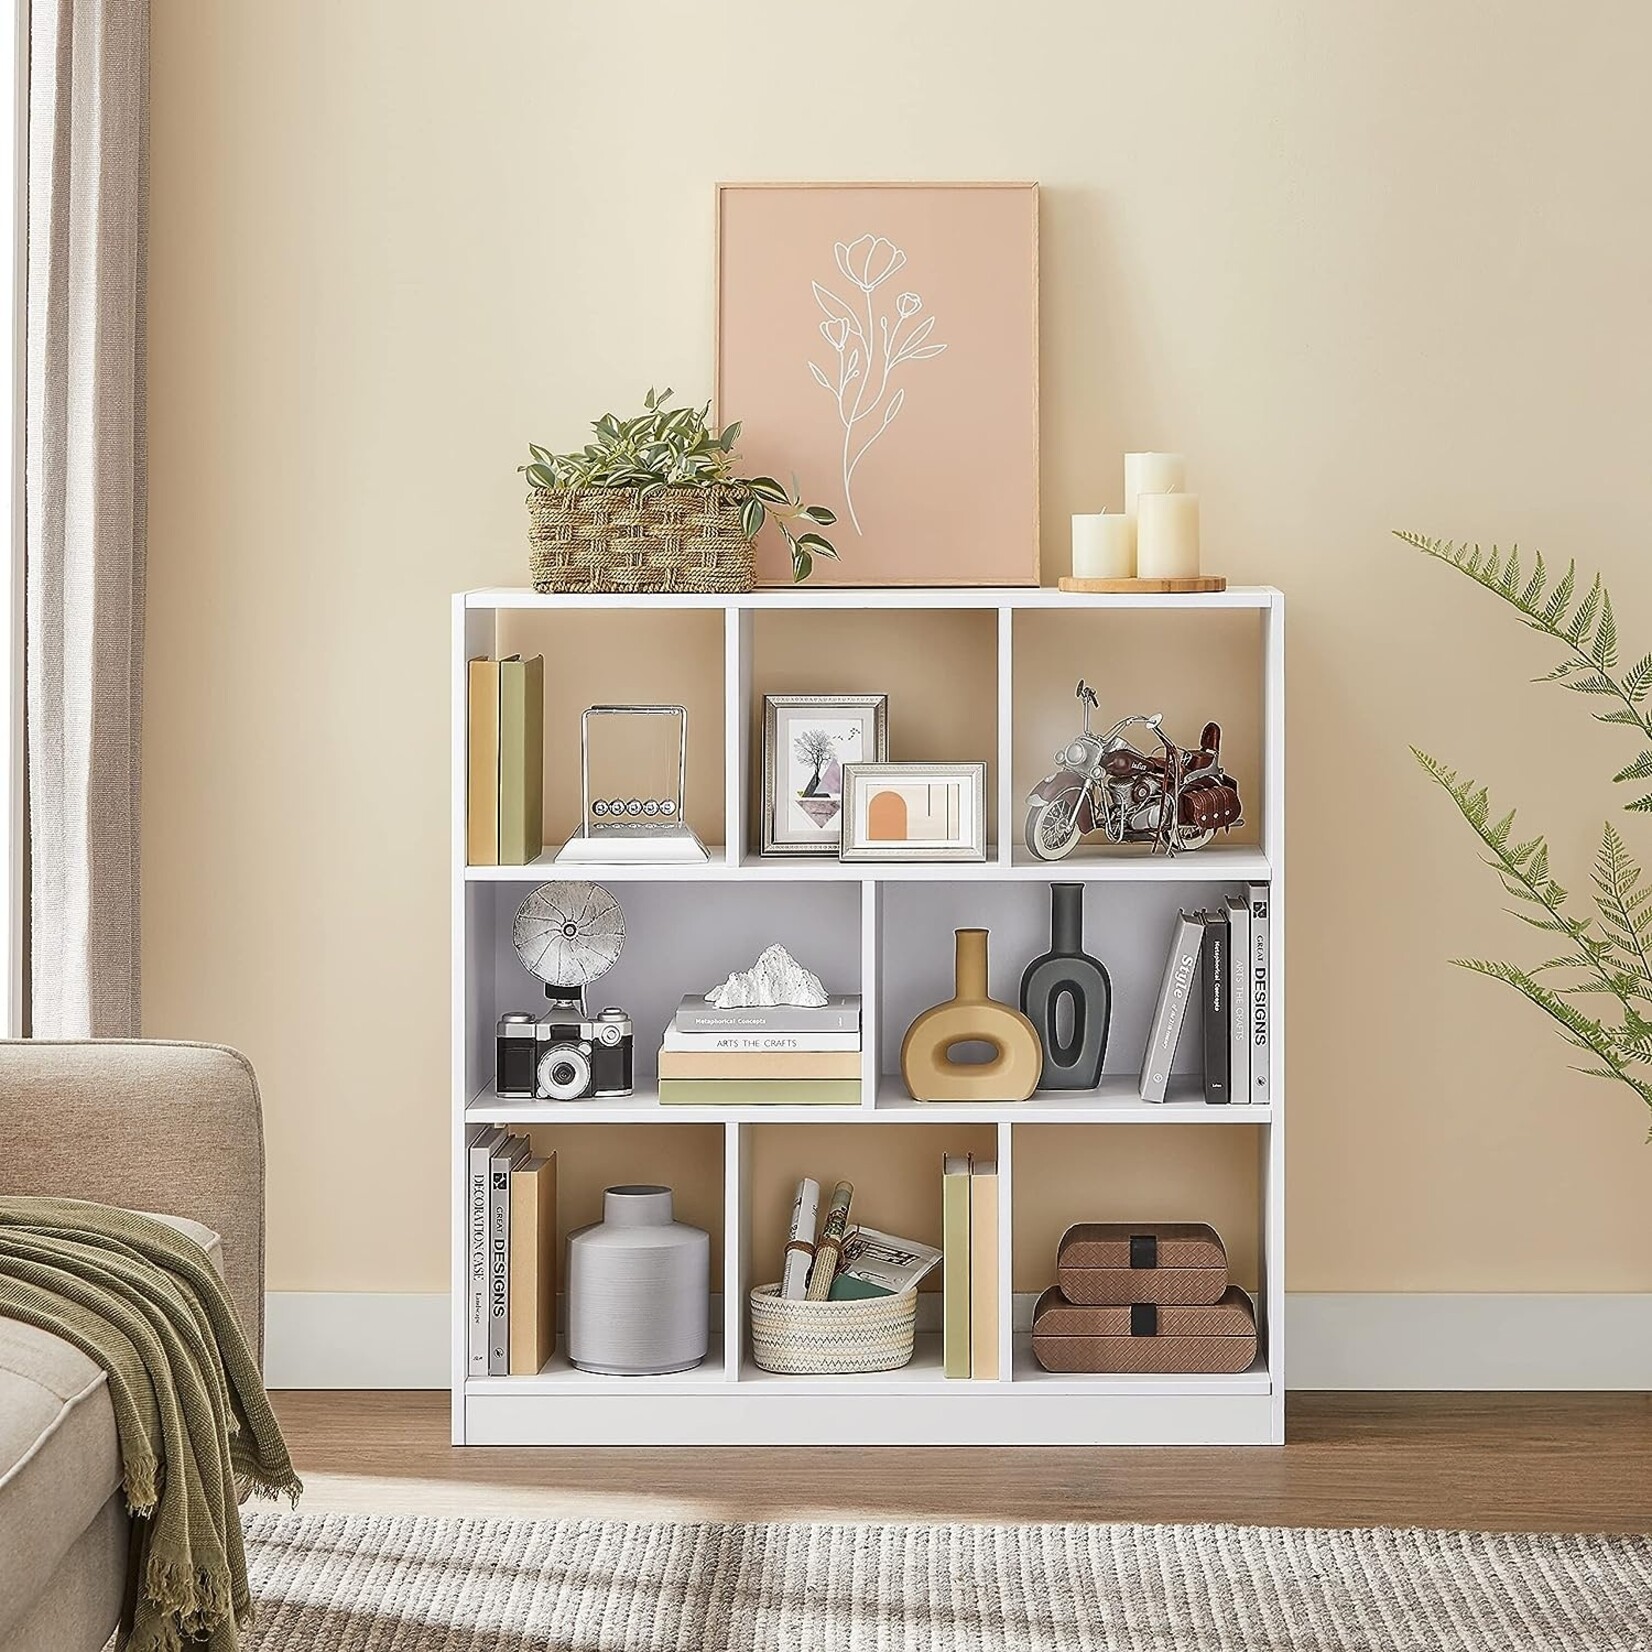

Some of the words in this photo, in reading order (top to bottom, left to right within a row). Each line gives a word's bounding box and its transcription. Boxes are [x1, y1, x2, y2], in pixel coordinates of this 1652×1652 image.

[1256, 935, 1264, 962] GREAT
[1173, 954, 1194, 999] Style
[1236, 960, 1244, 982] ARTS
[1236, 986, 1244, 1004] THE
[1255, 967, 1266, 1046] DESIGNS
[1235, 1007, 1244, 1041] CRAFTS
[716, 1039, 739, 1048] ARTS
[743, 1039, 760, 1048] THE
[763, 1039, 798, 1048] CRAFTS
[474, 1174, 485, 1251] DECORATION
[496, 1206, 504, 1234] GREAT
[473, 1252, 485, 1281] CASE
[493, 1238, 505, 1318] DESIGNS
